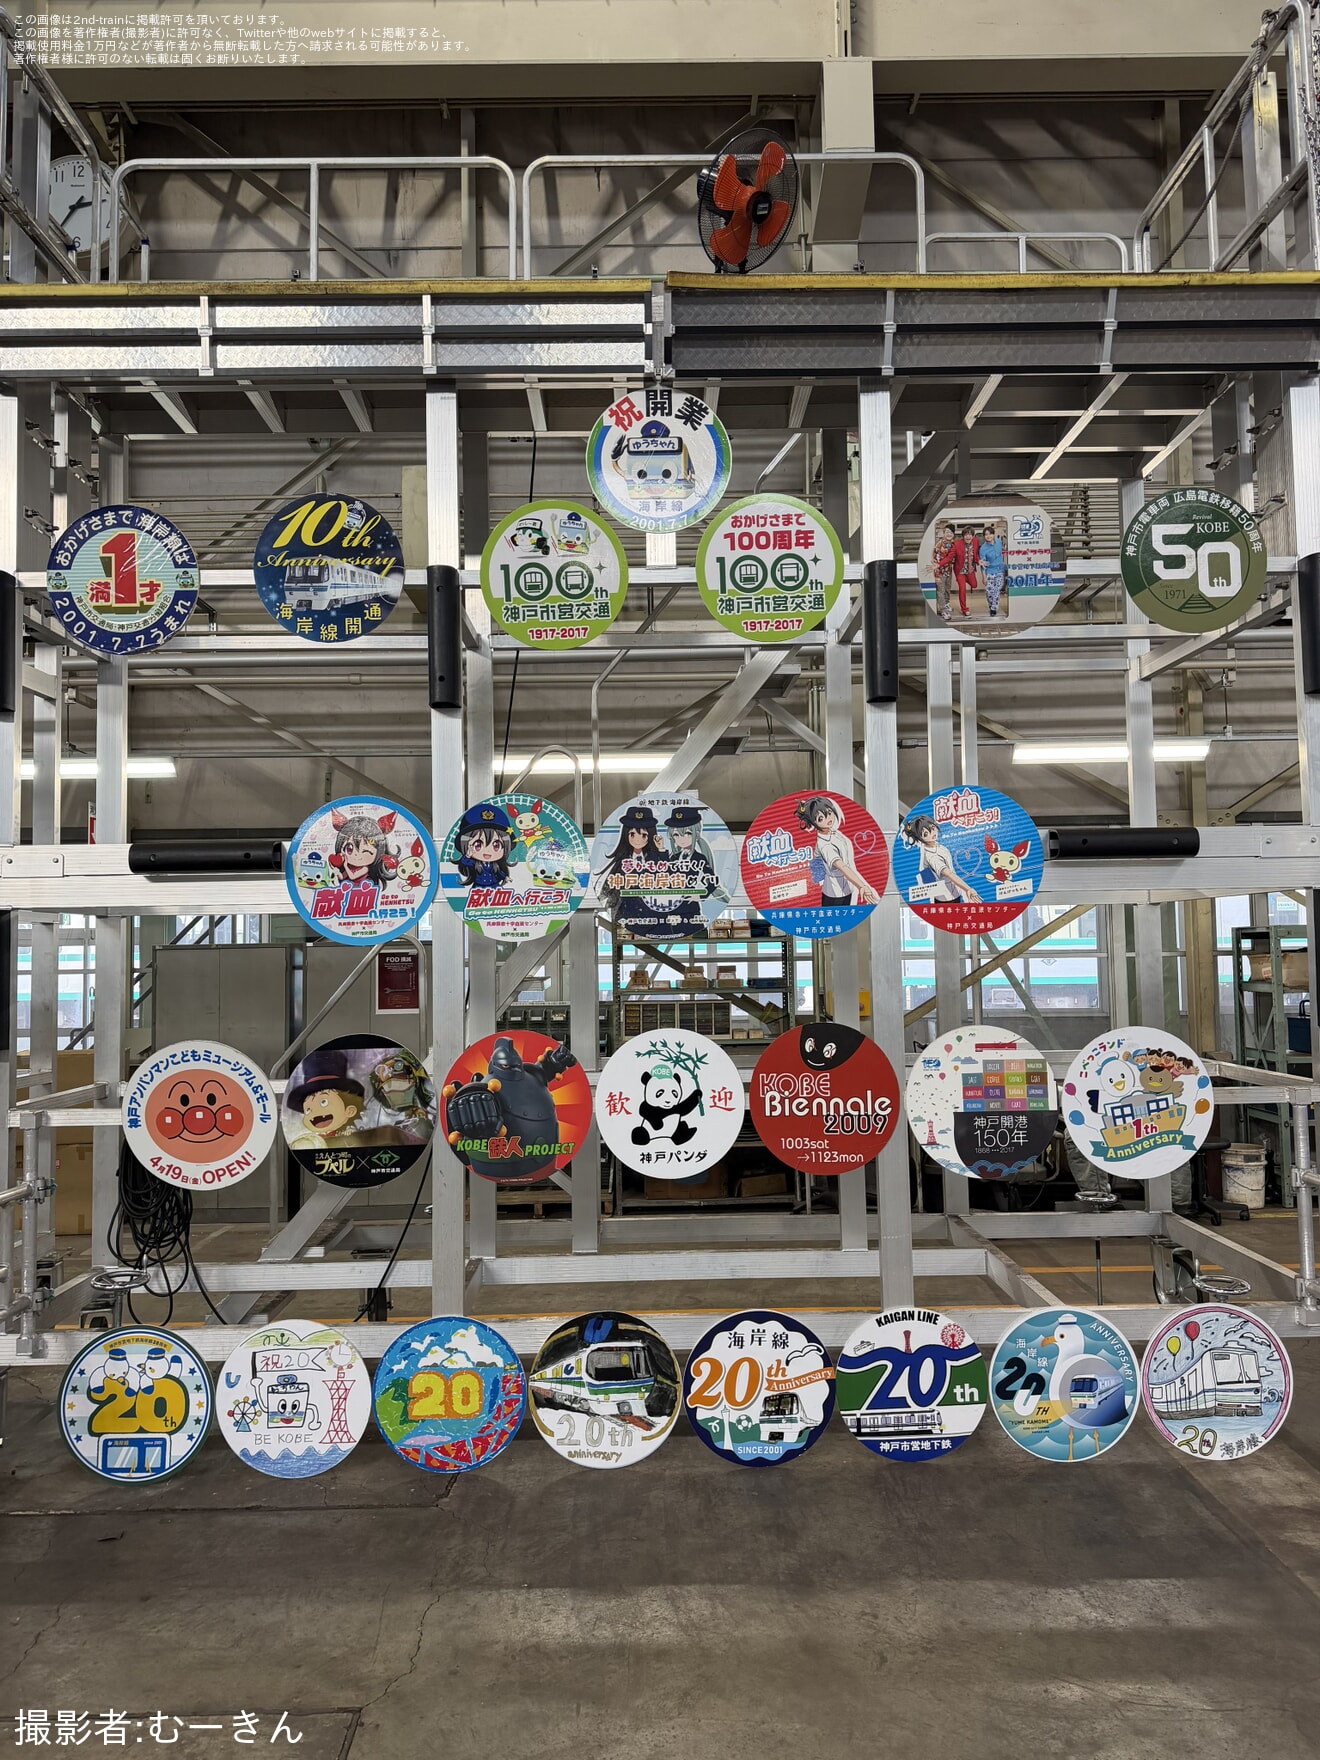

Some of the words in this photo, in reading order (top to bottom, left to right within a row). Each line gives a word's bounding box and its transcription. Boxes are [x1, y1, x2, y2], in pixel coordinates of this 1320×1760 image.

[55, 170, 64, 182] 11
[73, 165, 85, 178] 12
[608, 390, 709, 431] 祝開業
[632, 438, 676, 450] ゆうちゃん
[638, 500, 683, 512] 海岸線
[272, 500, 382, 548] 10th
[630, 514, 689, 531] 2001.7.7
[731, 513, 806, 528] おかげさまで
[1196, 522, 1230, 534] KOBE
[724, 530, 815, 551] 100周年
[257, 550, 398, 579] Anniversary
[718, 593, 826, 614] 神戸市営交通
[1164, 590, 1187, 600] 1971
[274, 602, 382, 640] 海岸線開通
[503, 602, 611, 622] 神戸市営交通
[528, 626, 589, 640] 1917-2017
[743, 619, 803, 632] 1917-2017
[608, 873, 720, 890] 神戸海岸街めぐり
[652, 1067, 670, 1076] KOBE
[760, 1072, 830, 1098] KOBE
[765, 1090, 892, 1116] Biennale
[824, 1113, 888, 1135] 2009
[973, 1116, 1028, 1129] 神戸開港
[1132, 1118, 1158, 1139] 1th
[456, 1138, 488, 1152] KOBE
[488, 1136, 524, 1158] 鉄人
[524, 1143, 574, 1156] PROJECT
[780, 1138, 830, 1150] 1003sat
[973, 1128, 1028, 1148] 150年
[1106, 1133, 1183, 1158] Anniversary
[313, 1158, 355, 1176] プペル
[640, 1150, 708, 1164] 神戸パンダ
[202, 1151, 256, 1184] OPEN!
[876, 1310, 915, 1328] KAIGAN
[918, 1310, 940, 1326] LINE
[728, 1328, 790, 1350] 海岸線
[260, 1352, 310, 1372] 祝20
[1090, 1322, 1134, 1382] ANNIVERSARY
[770, 1369, 834, 1392] Anniversary
[408, 1370, 484, 1420] 20
[254, 1434, 272, 1445] BE
[278, 1433, 314, 1444] KOBE
[556, 1414, 634, 1447] 20th
[738, 1446, 762, 1454] SINCE
[764, 1446, 783, 1454] 2001
[880, 1440, 952, 1452] 神戸市営地下鉄
